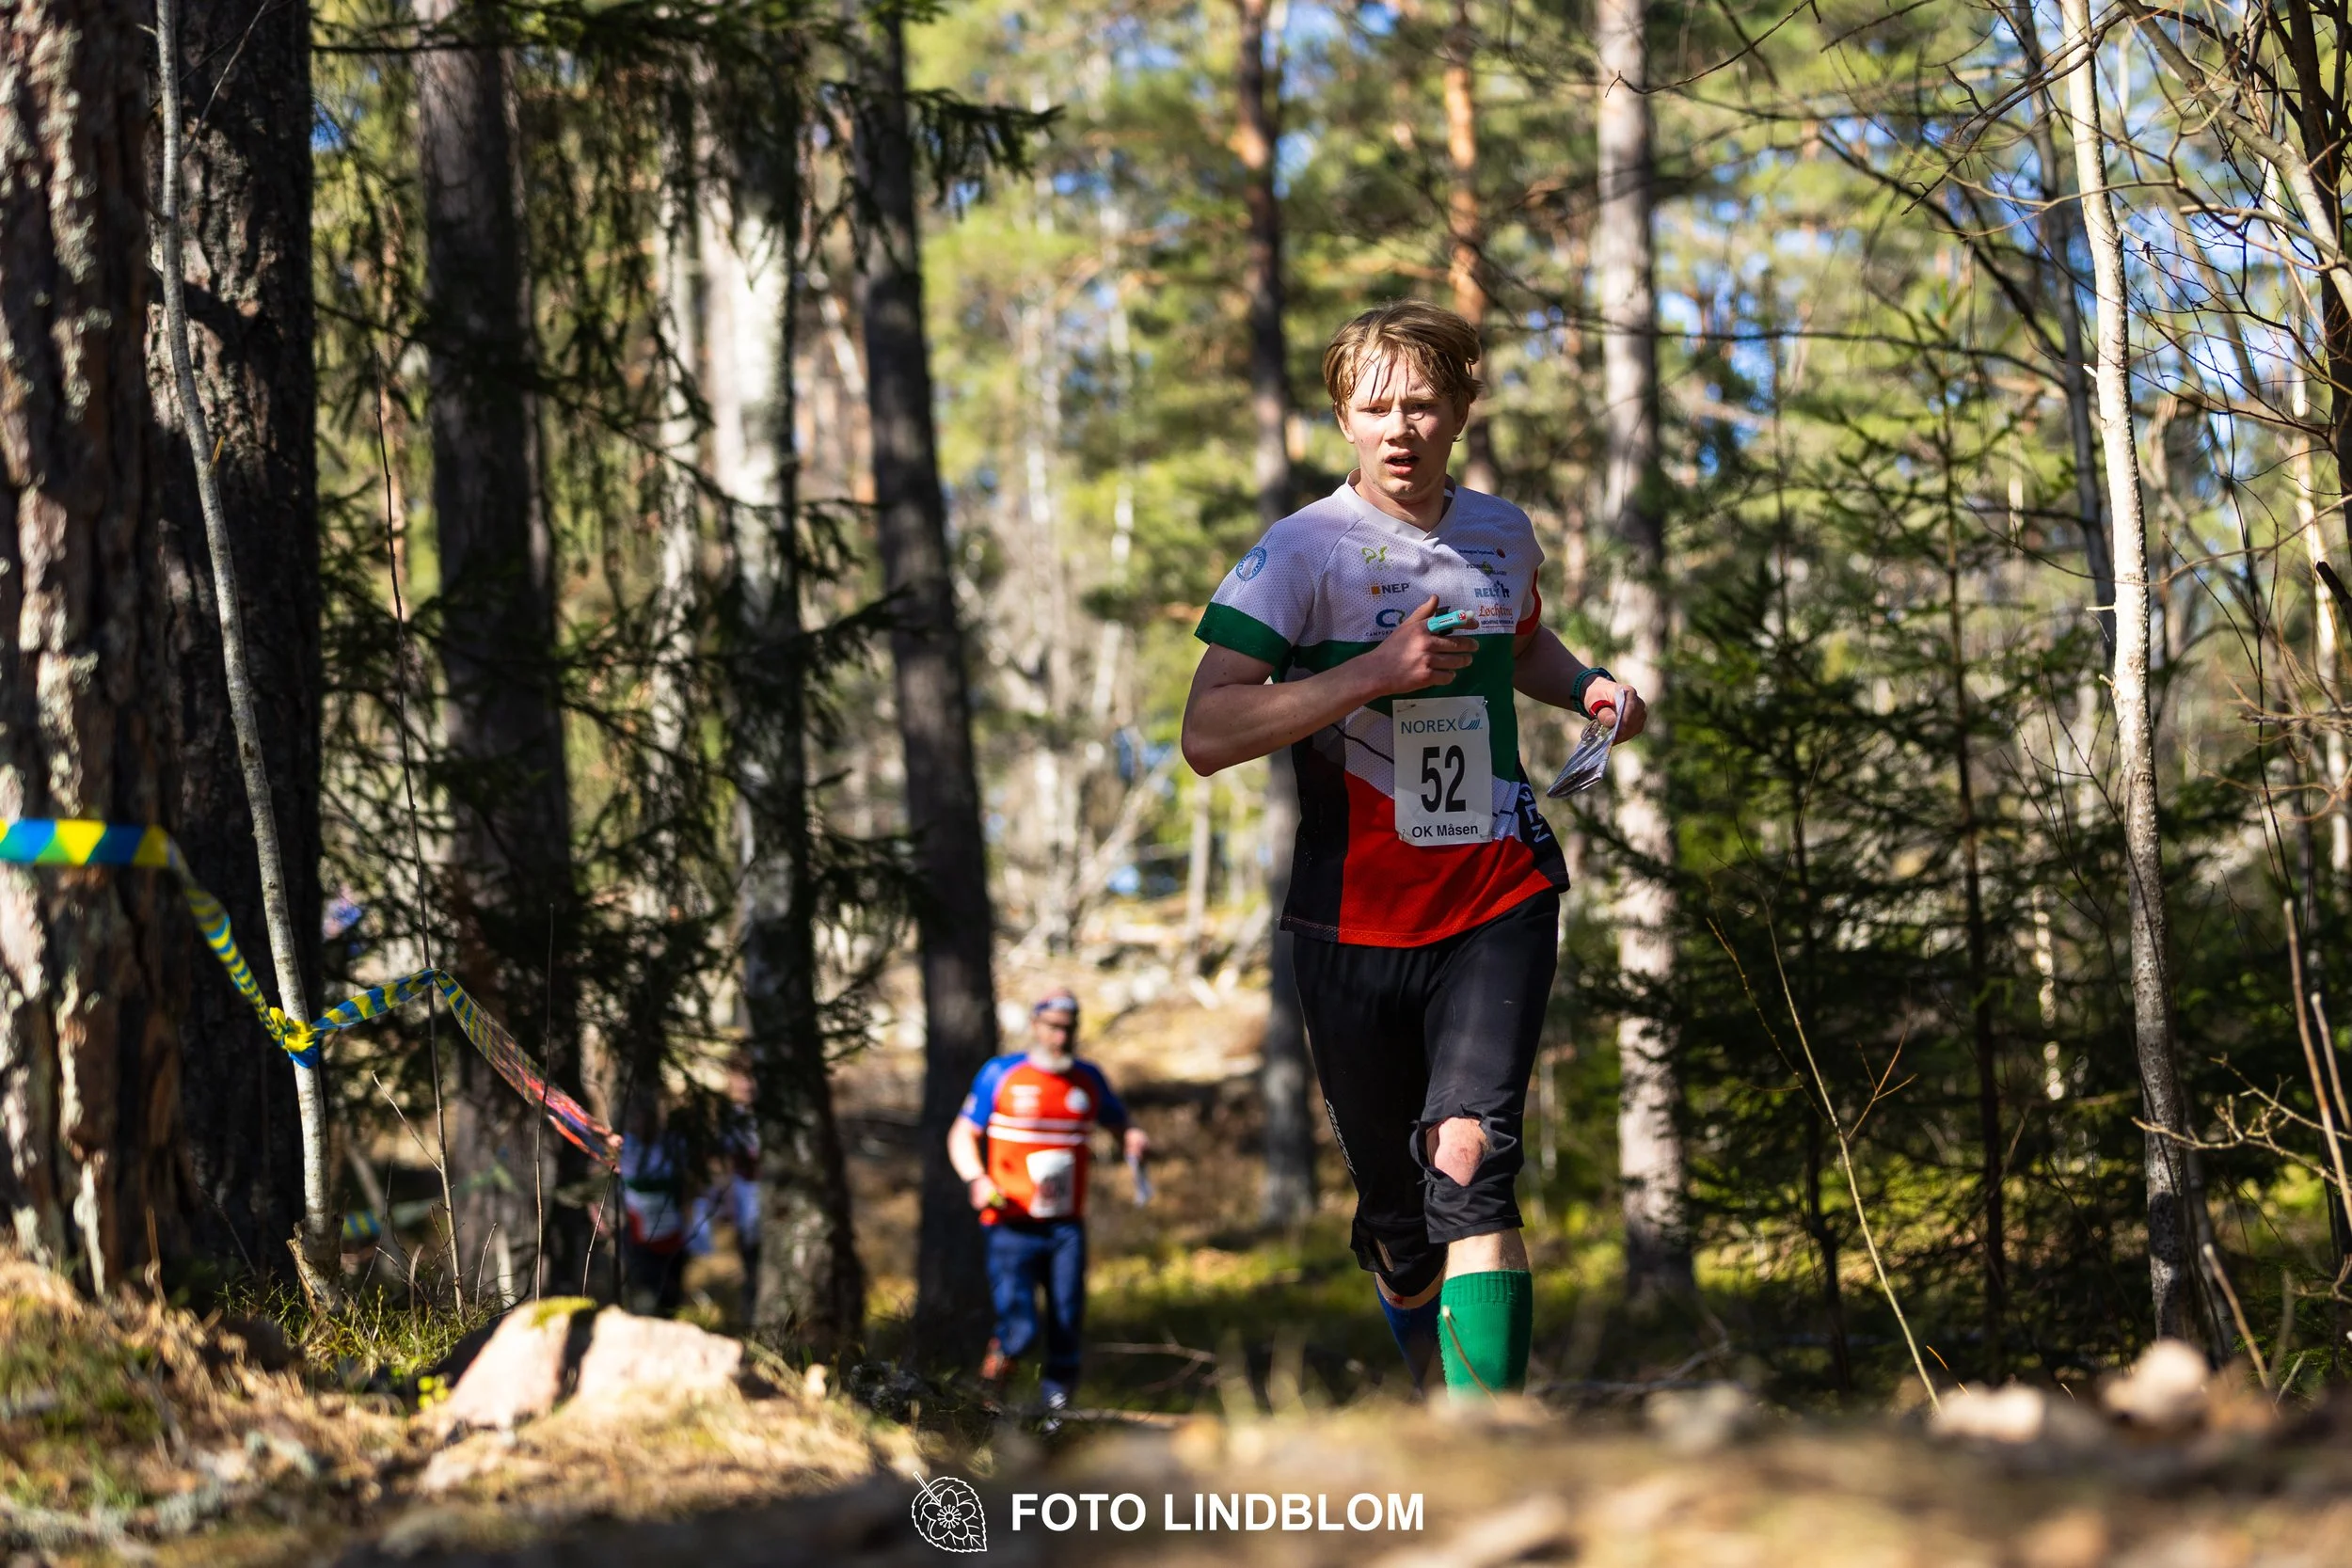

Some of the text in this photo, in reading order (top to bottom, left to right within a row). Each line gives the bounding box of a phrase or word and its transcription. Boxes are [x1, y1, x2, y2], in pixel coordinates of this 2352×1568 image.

[1382, 583, 1410, 594] NEP
[1401, 719, 1457, 734] NOREX
[1421, 745, 1467, 813] 52
[1412, 824, 1479, 838] OK Måsen
